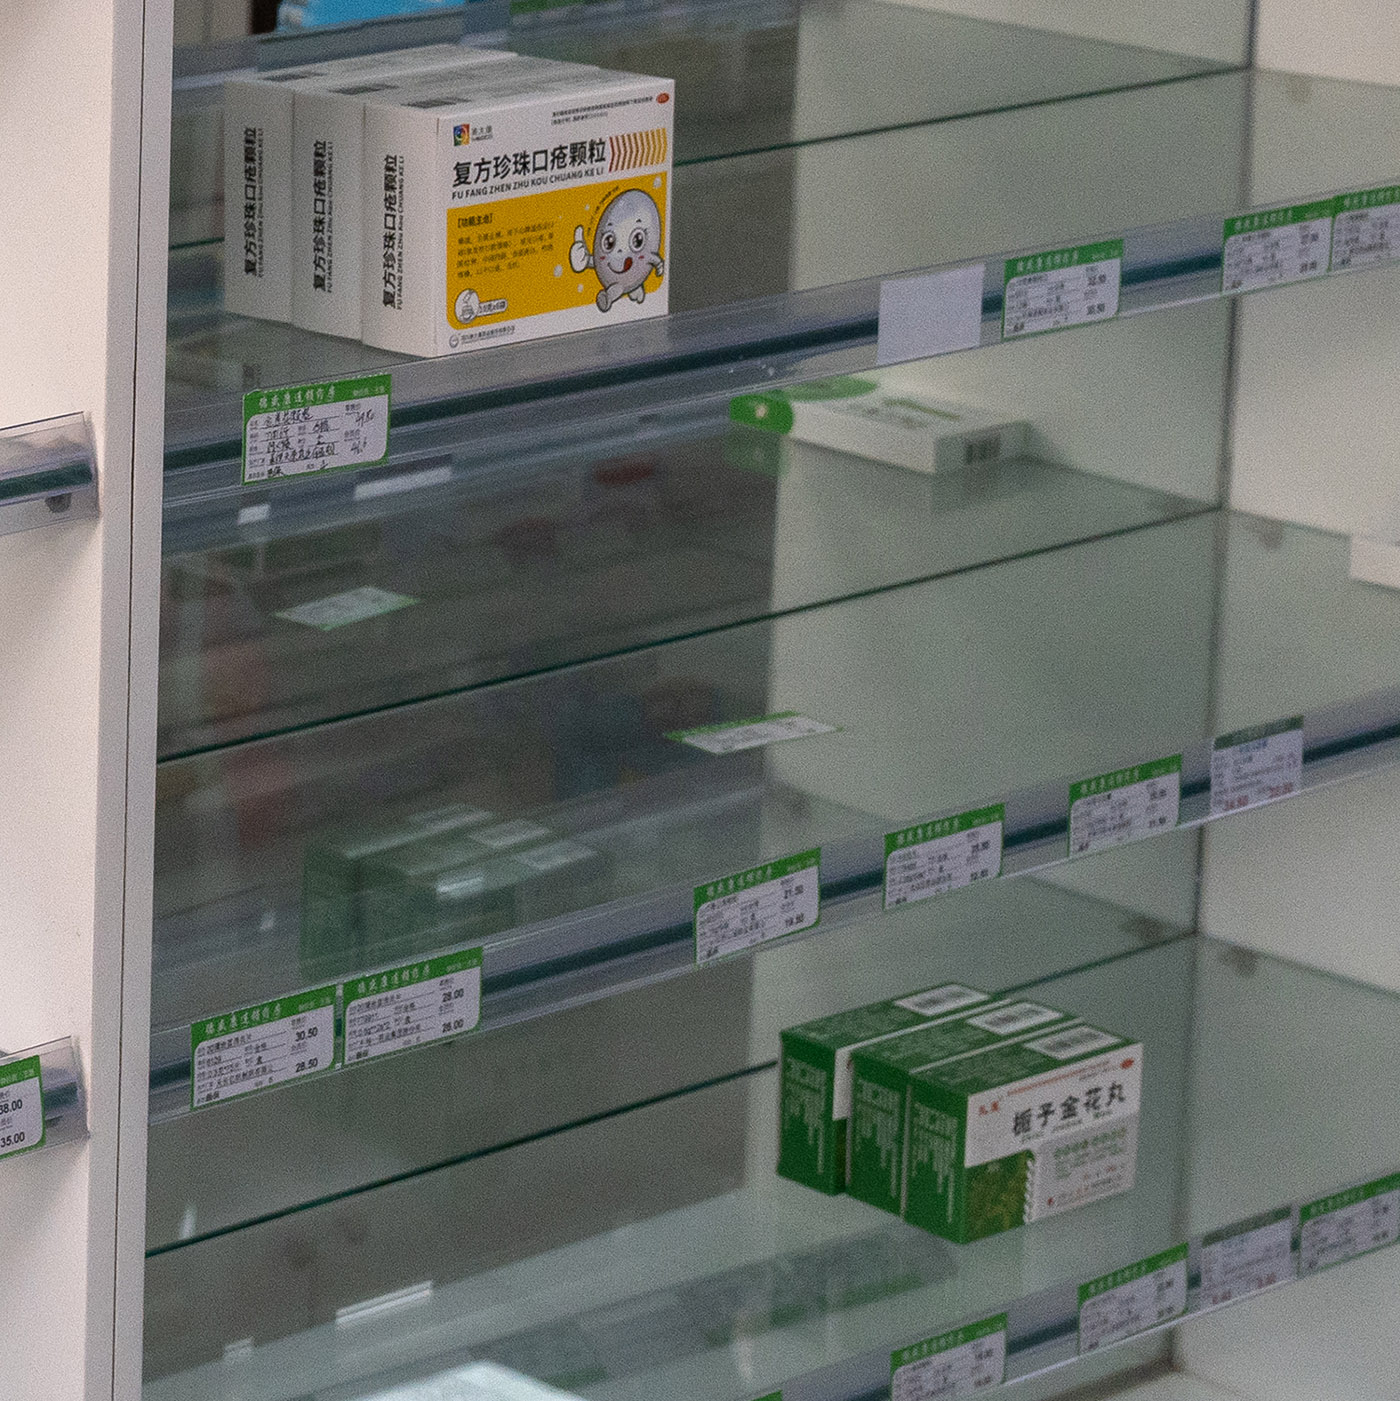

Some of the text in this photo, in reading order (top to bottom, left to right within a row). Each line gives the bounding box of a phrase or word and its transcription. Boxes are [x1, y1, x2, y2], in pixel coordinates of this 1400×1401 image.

[452, 138, 607, 188] 复方珍珠口疮颗粒
[312, 139, 328, 293] 复方珍珠口疮颗粒
[451, 190, 464, 200] FU
[466, 186, 487, 198] FANG
[489, 182, 511, 194] ZHEN
[382, 154, 398, 309] 复方珍珠口疮颗粒
[0, 1132, 25, 1148] 35.00
